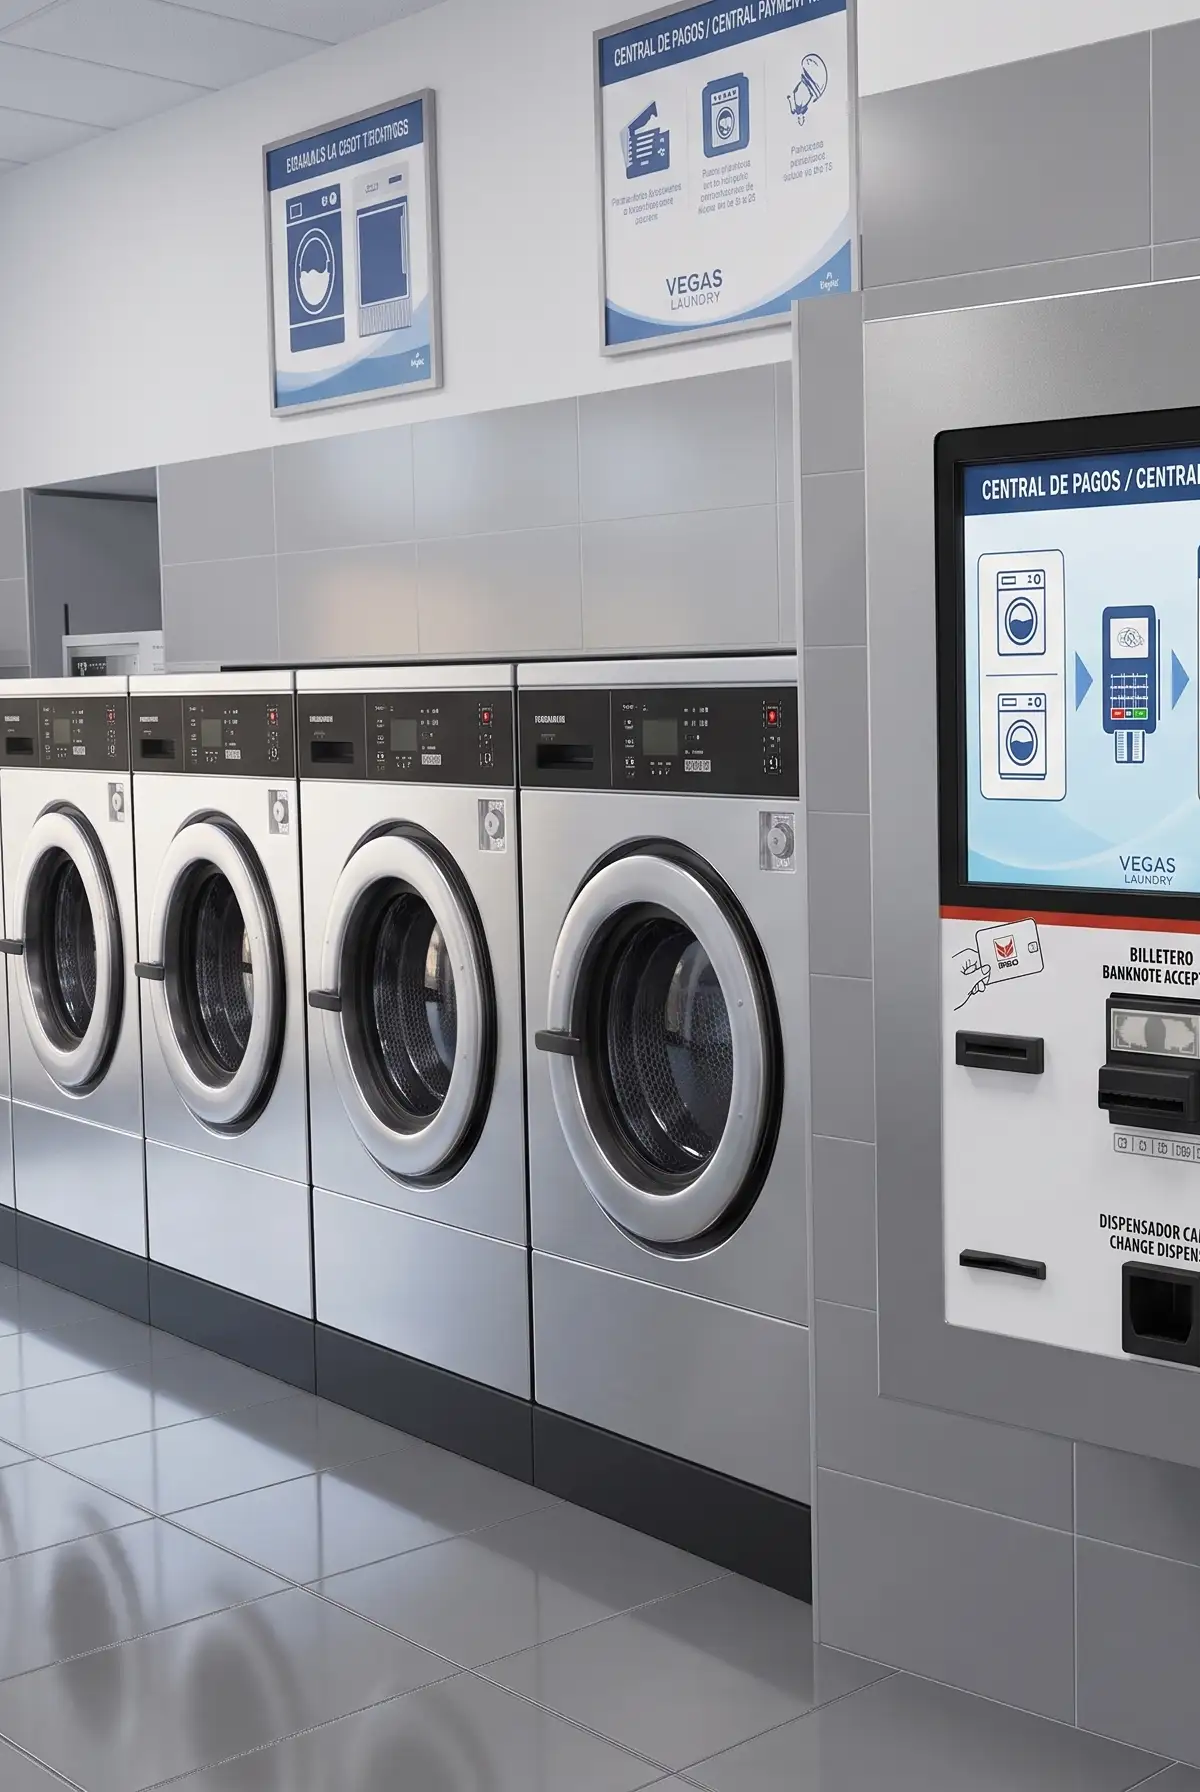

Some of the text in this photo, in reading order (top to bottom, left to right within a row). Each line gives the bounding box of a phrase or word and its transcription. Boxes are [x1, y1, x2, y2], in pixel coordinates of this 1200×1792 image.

[614, 37, 656, 67] CENTRAL
[657, 33, 671, 53] DE
[672, 21, 705, 49] PAGOS
[705, 17, 711, 39] /
[712, 8, 757, 35] CENTRAL
[666, 268, 723, 296] VEGAS
[670, 291, 721, 311] LAUNDRY
[982, 476, 1046, 501] CENTRAL
[1050, 474, 1069, 497] DE
[1072, 469, 1121, 495] PAGOS
[1124, 468, 1133, 491] /
[1119, 855, 1176, 873] VEGAS
[1124, 873, 1174, 886] LAUNDRY
[1130, 947, 1194, 966] BILLETERO
[1102, 965, 1162, 983] BANKNOTE
[1099, 1213, 1180, 1240] DISPENSADOR
[1110, 1235, 1154, 1255] CHANGE
